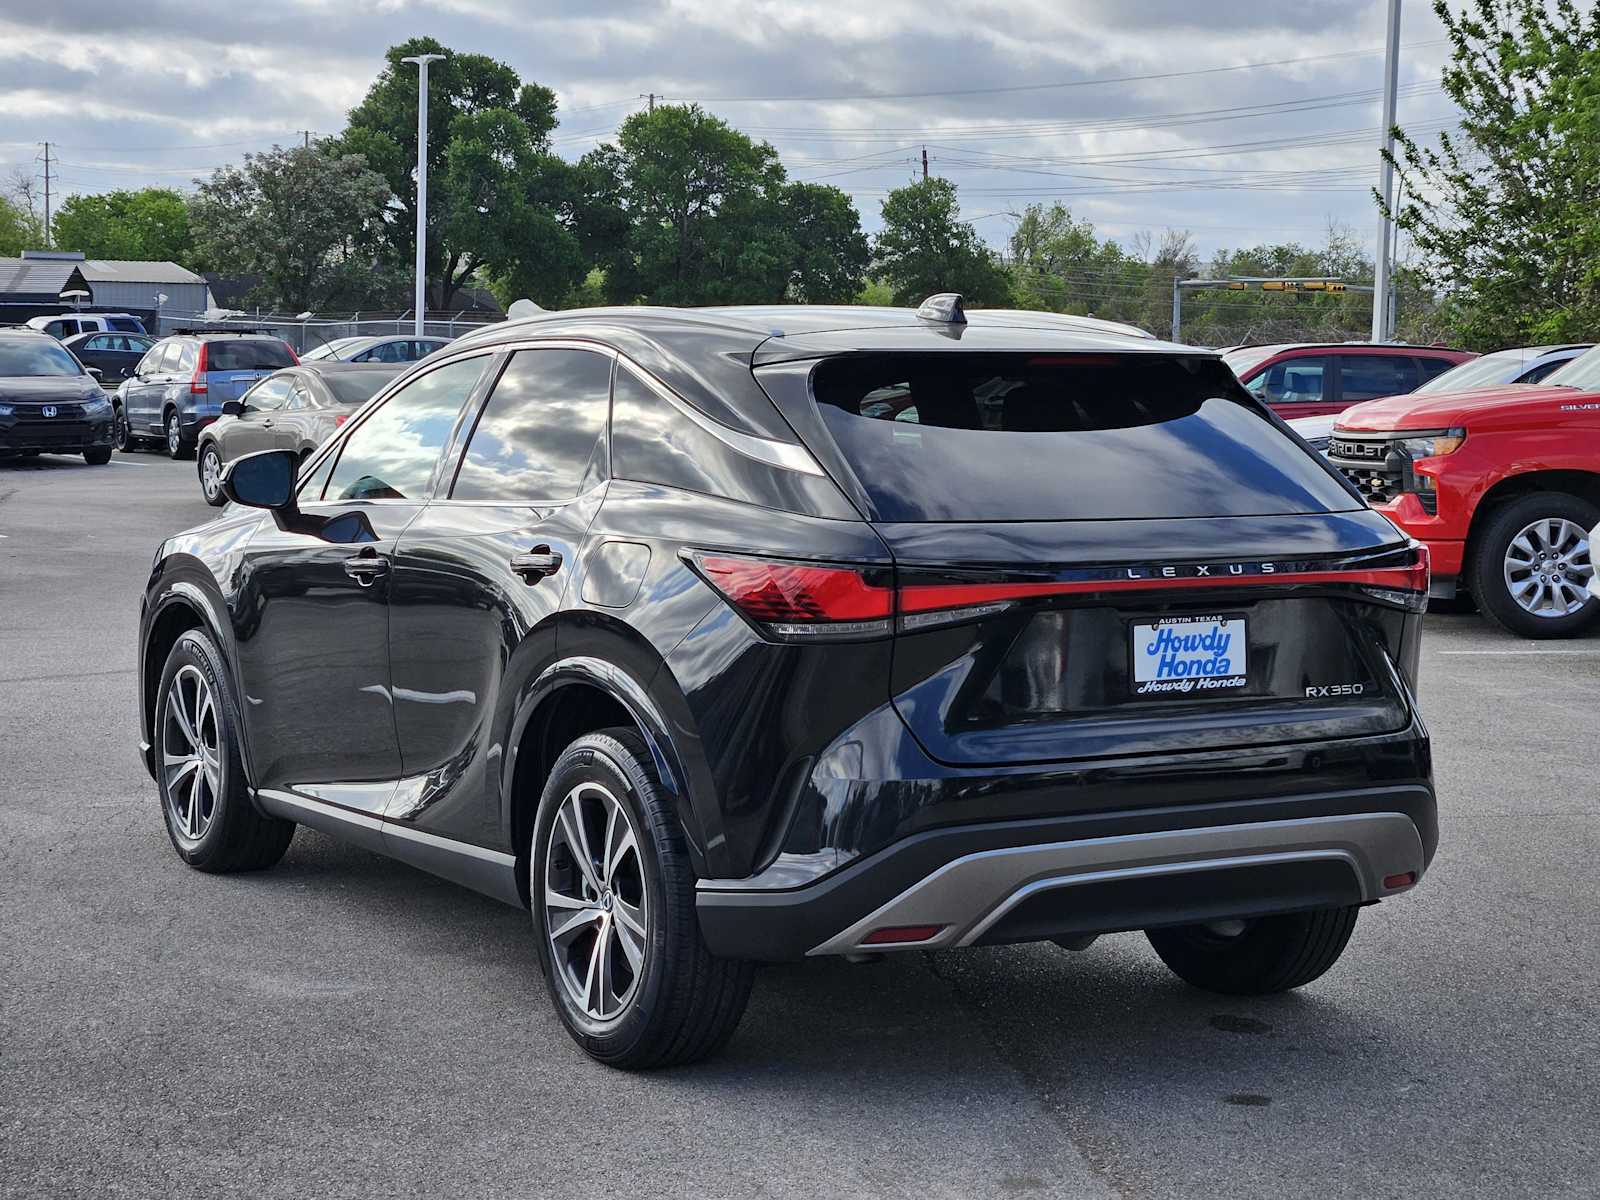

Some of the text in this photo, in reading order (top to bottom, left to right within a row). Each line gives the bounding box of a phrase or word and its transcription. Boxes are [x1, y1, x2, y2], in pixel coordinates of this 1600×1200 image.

[1127, 562, 1275, 579] LEXUS
[1159, 614, 1223, 624] AUSTIN TEXAS
[1146, 626, 1231, 657] Howdy
[1157, 653, 1231, 678] Honda
[1137, 676, 1246, 693] Howdy Honda
[1305, 683, 1364, 698] RX350
